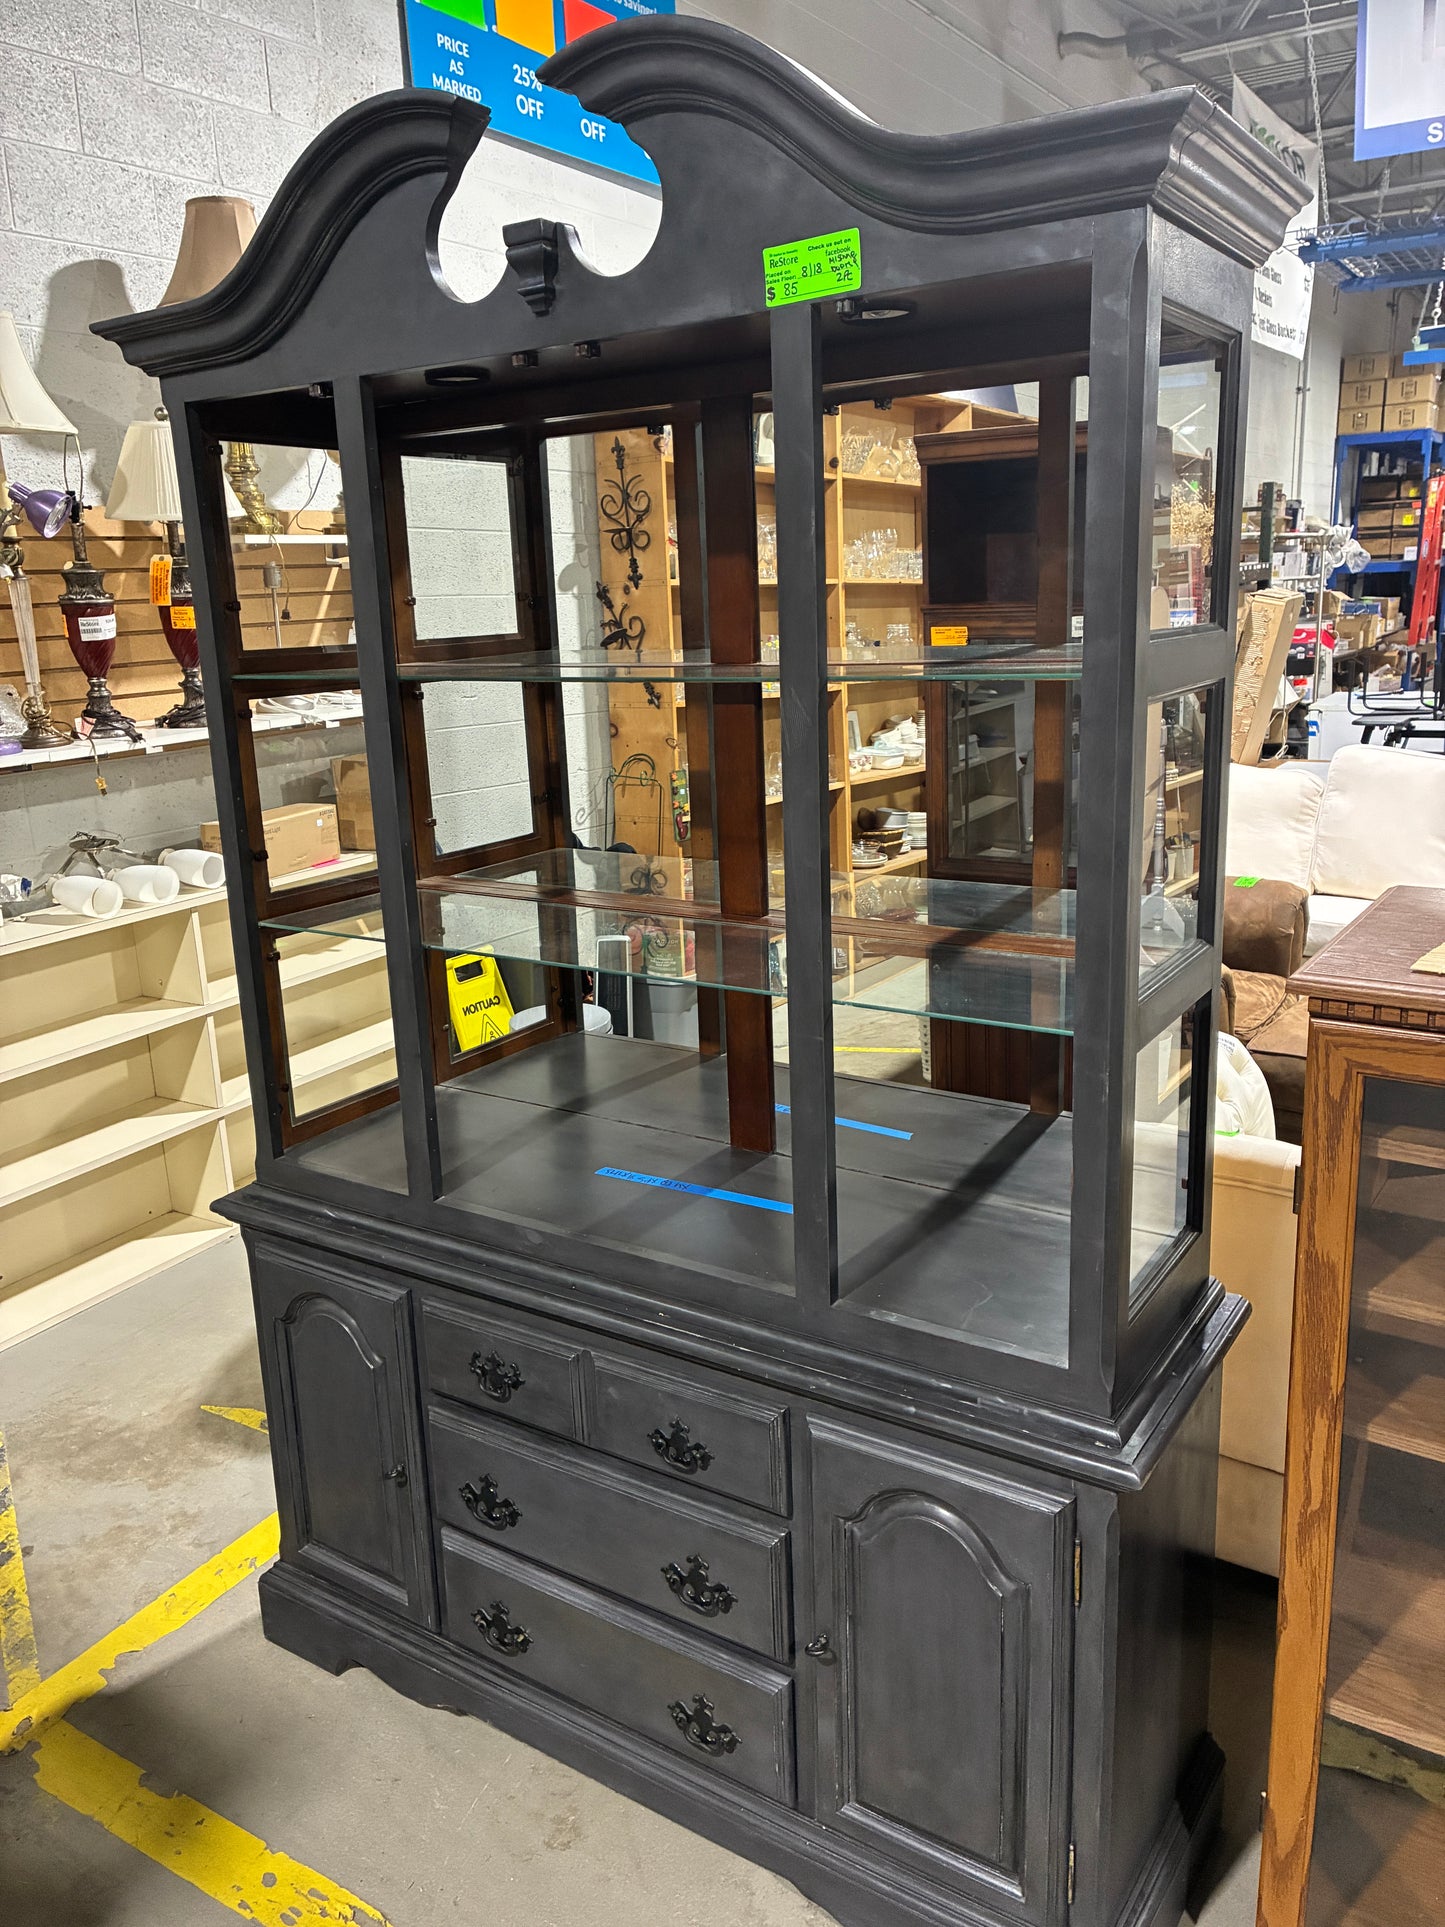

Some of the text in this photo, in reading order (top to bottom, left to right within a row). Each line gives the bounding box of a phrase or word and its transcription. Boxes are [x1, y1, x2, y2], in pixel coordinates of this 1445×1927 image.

[436, 32, 470, 58] PRICE
[449, 58, 464, 76] AS
[512, 63, 543, 92] 25%
[432, 72, 482, 103] MARKED
[515, 94, 544, 120] OFF
[580, 118, 606, 143] OFF
[769, 256, 798, 268] ReStore
[825, 245, 851, 256] facebook
[767, 281, 798, 302] $ 85
